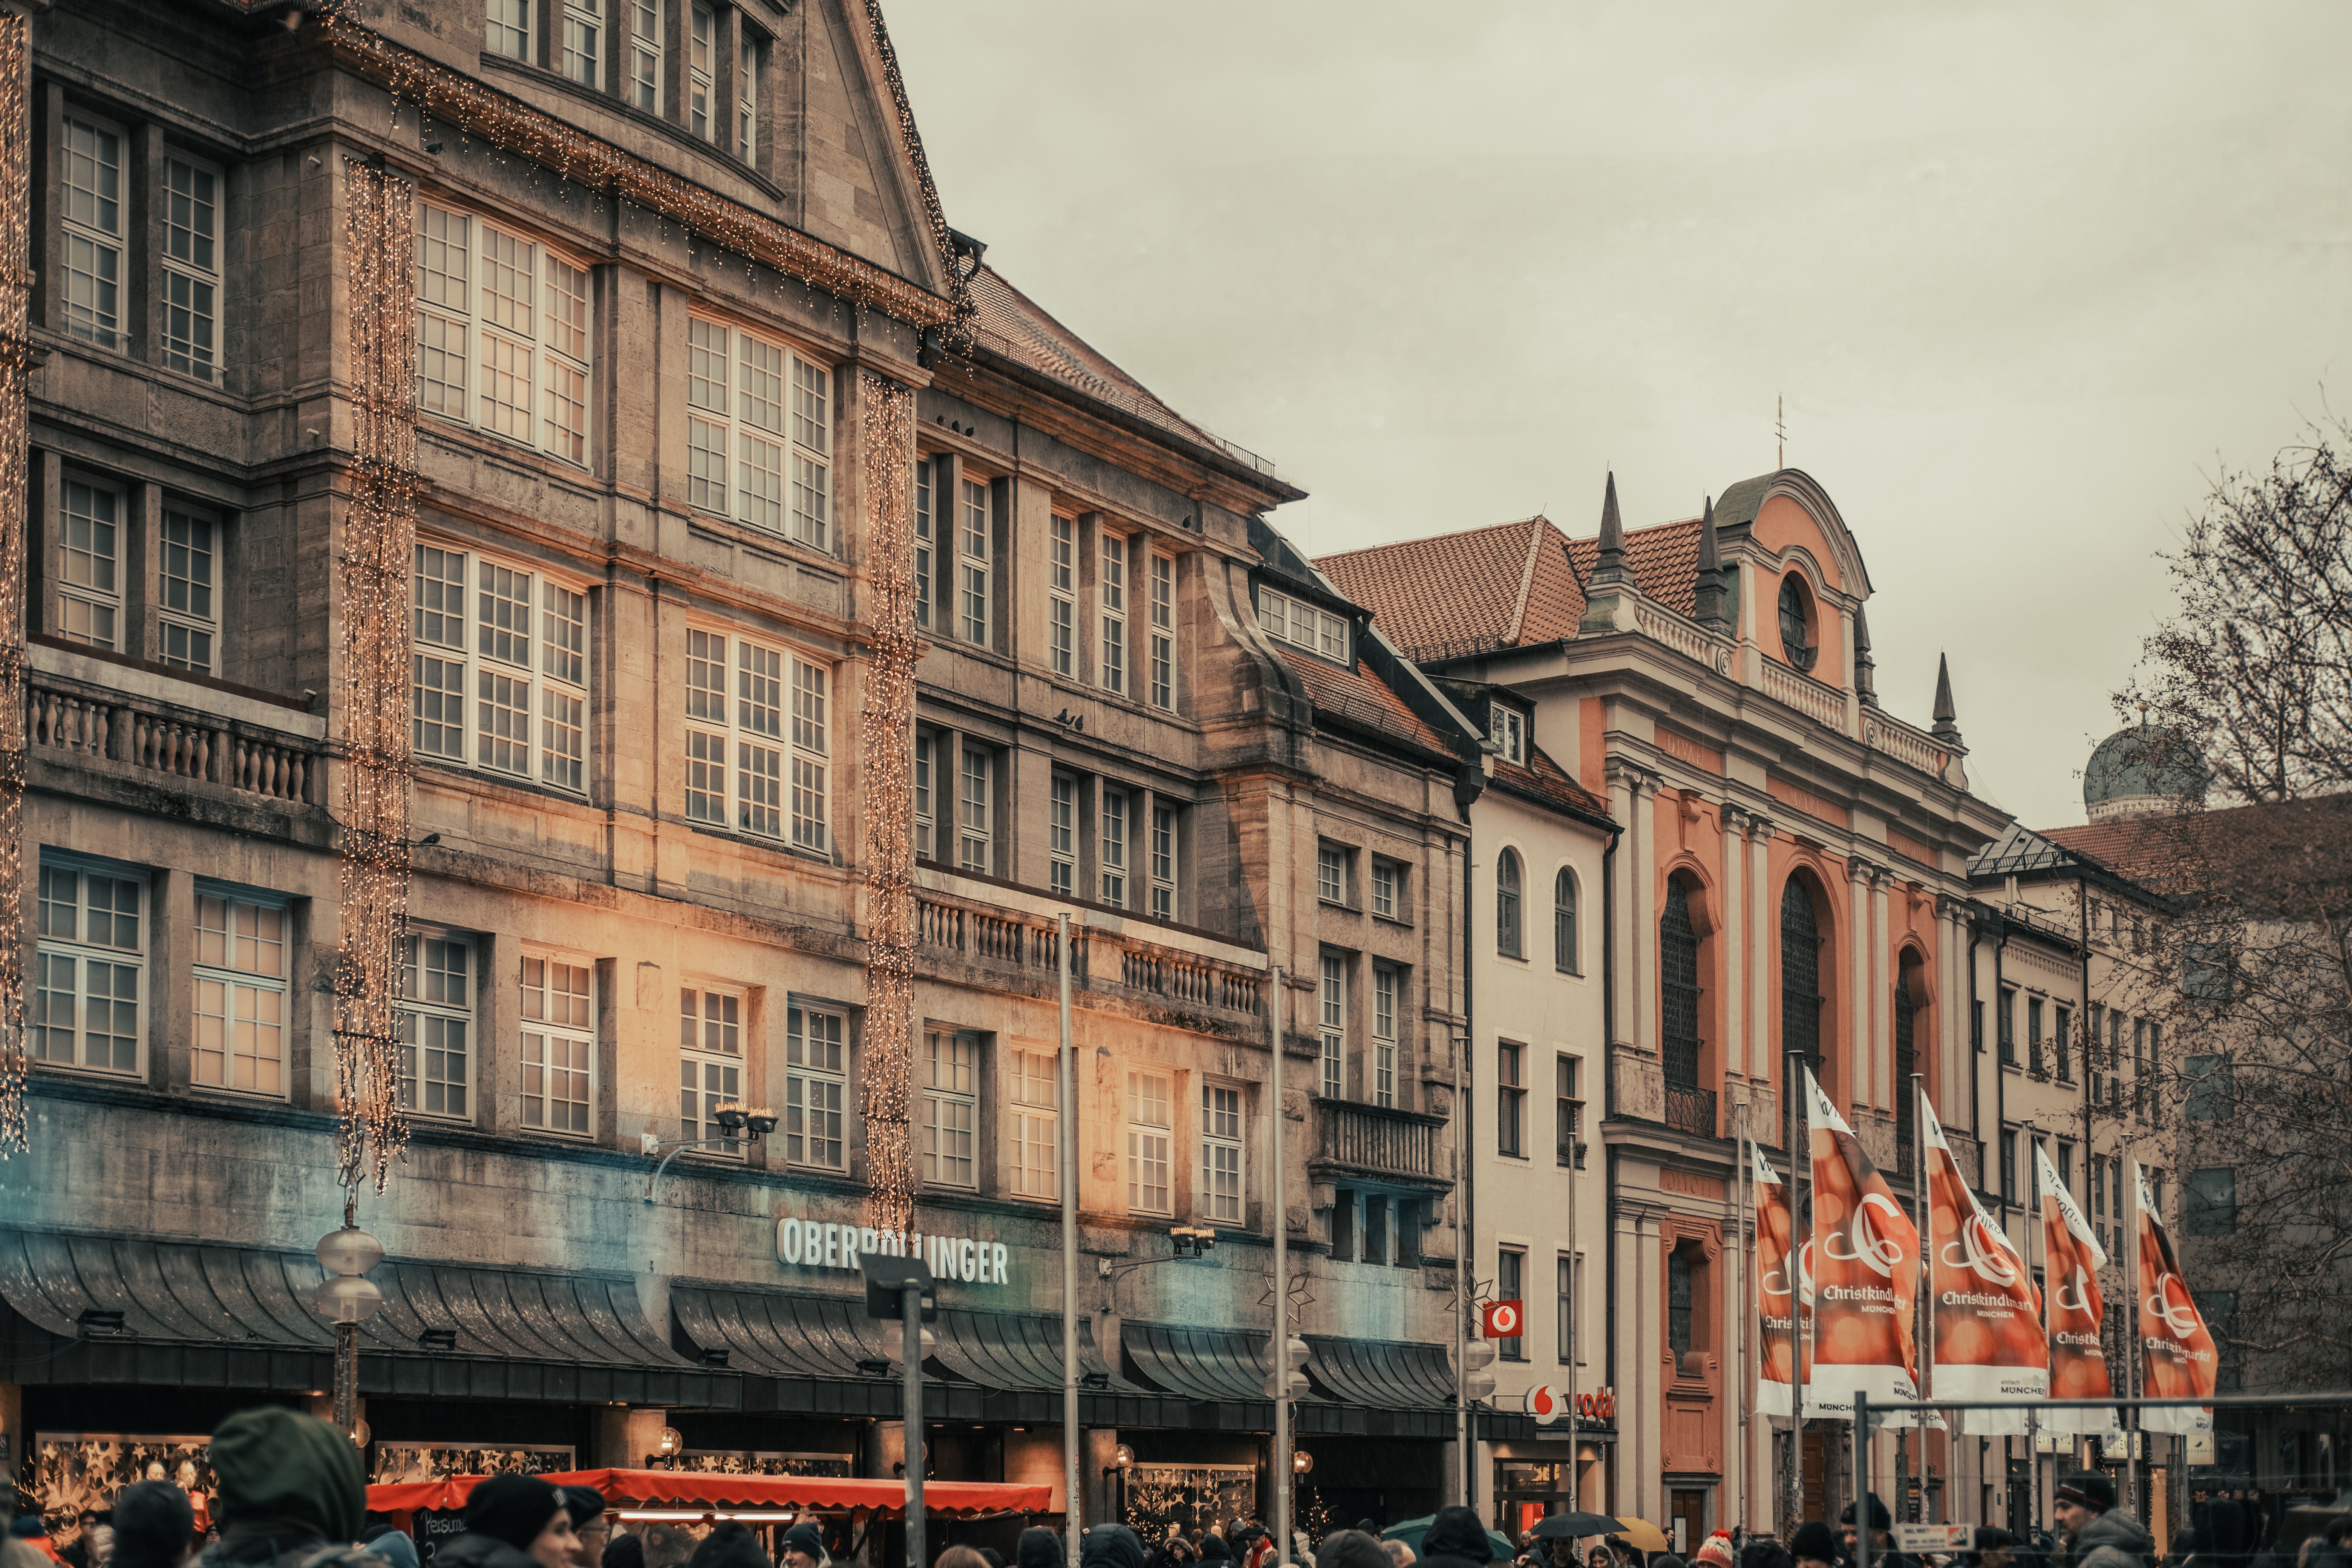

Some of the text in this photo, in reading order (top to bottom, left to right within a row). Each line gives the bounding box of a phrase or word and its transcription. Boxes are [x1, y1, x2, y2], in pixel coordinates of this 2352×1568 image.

[1668, 735, 1702, 766] DIVAE
[1790, 789, 1819, 815] MATRI
[2001, 1386, 2044, 1395] MÜNCHE
[1819, 1403, 1856, 1412] MÜNCHE
